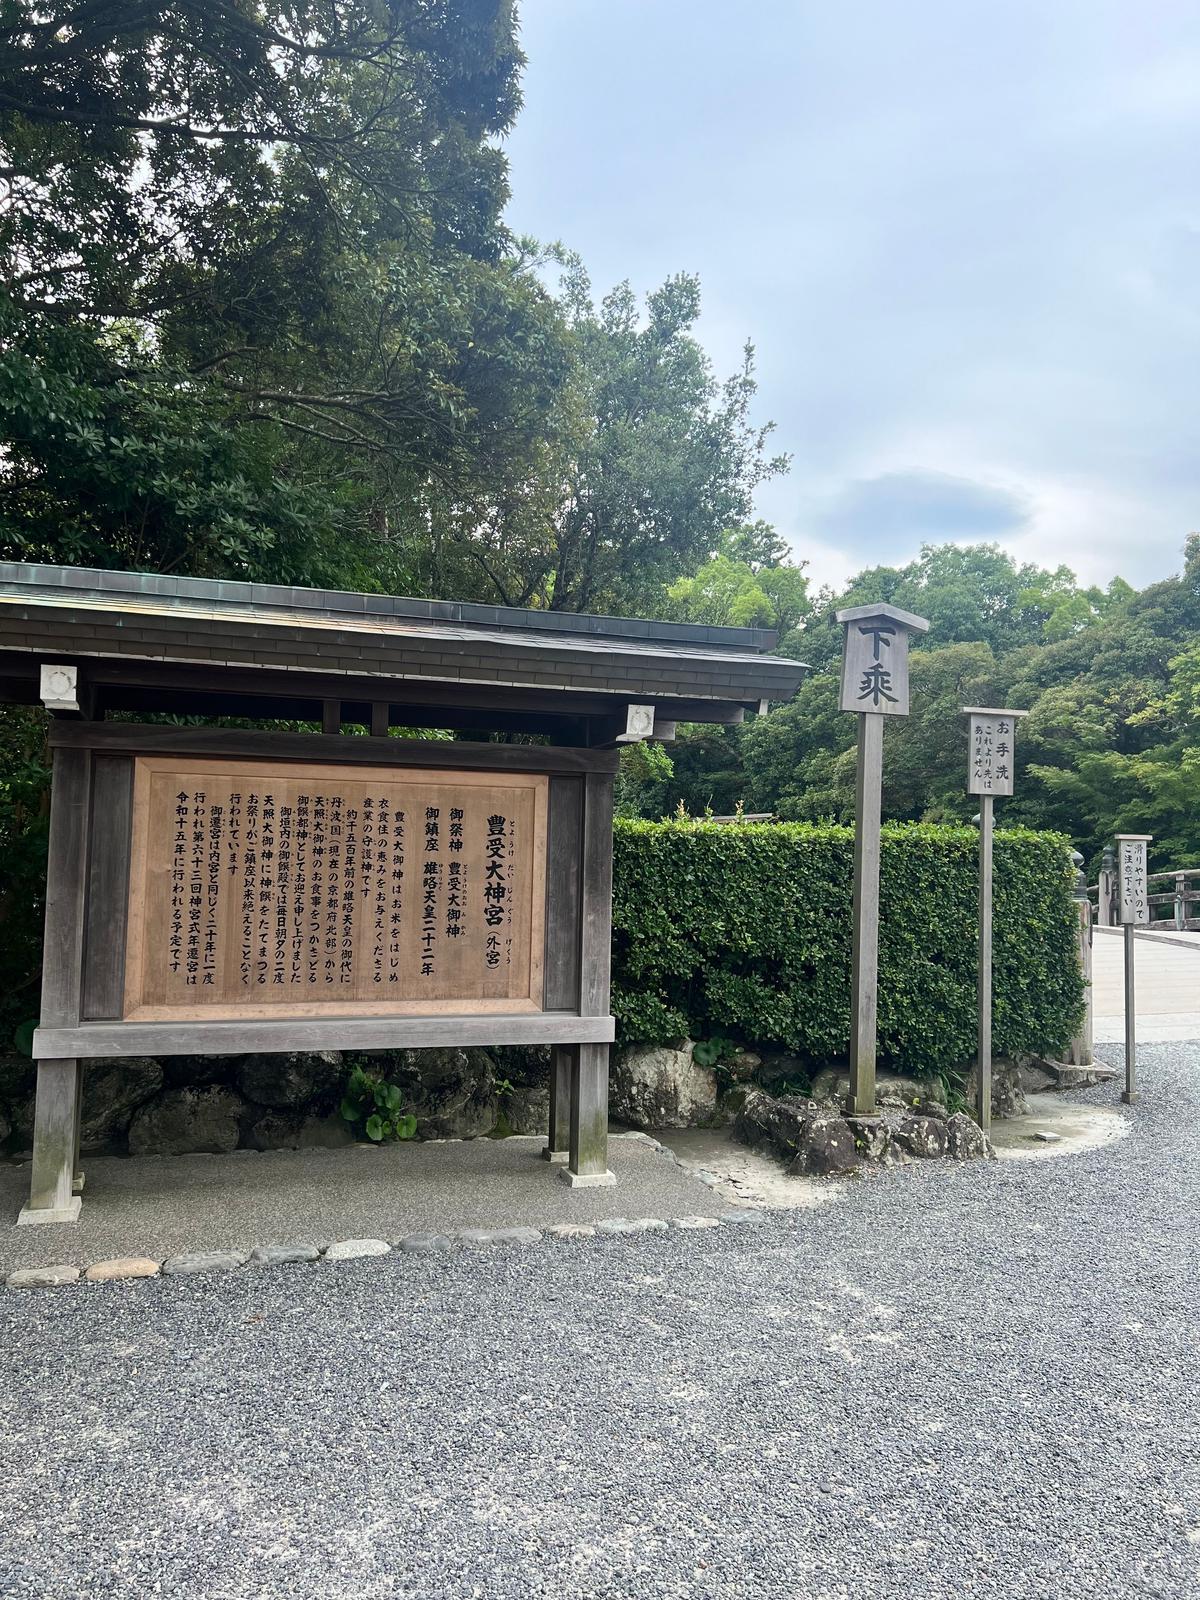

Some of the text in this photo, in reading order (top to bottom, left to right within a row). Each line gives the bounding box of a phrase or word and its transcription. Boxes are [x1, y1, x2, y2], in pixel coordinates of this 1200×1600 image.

[856, 626, 899, 706] 下乗
[974, 725, 983, 778] ありません
[983, 726, 993, 789] これより先は
[996, 721, 1010, 780] お手洗
[227, 793, 242, 875] 行われています
[448, 808, 464, 853] 御祭神
[169, 791, 189, 973] 令和十五年に行われる予定です
[186, 792, 206, 985] 行われ第六十三回神宮式年遷宮は
[240, 793, 259, 984] お祭りがご鎮座以来絶えることなく
[308, 796, 325, 983] 天照大御神のお食事をつかさどる
[340, 809, 358, 983] 約千五百年前の雄略天皇の御代に
[373, 798, 389, 983] 衣食住の恵みをお与えくださる
[420, 806, 440, 976] 御鎮座 雄略天皇二十二年
[1124, 844, 1133, 906] ご注意下さい
[1134, 844, 1144, 919] 滑りやすいので
